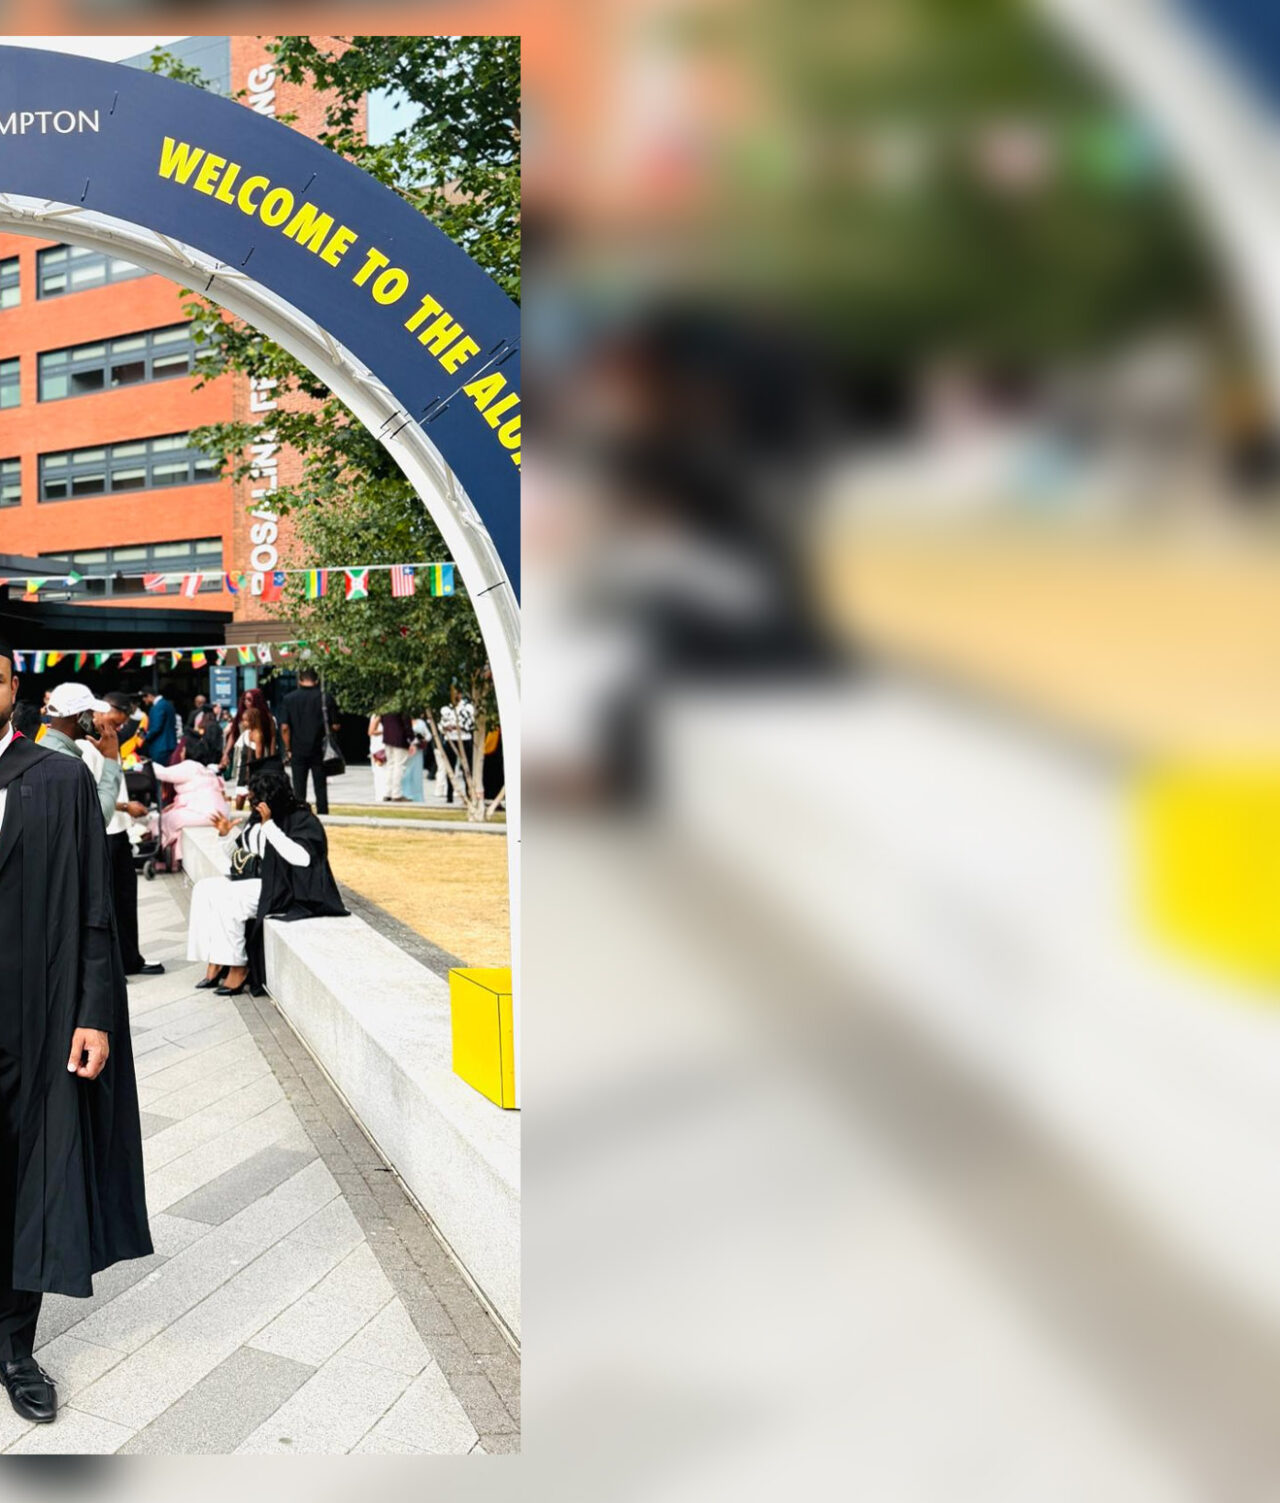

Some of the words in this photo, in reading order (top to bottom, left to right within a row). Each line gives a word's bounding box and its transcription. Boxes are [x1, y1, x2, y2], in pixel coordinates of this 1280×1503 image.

[248, 64, 276, 119] NG
[158, 136, 359, 268] WELCOME
[352, 247, 410, 305] TO
[404, 293, 481, 375] THE
[462, 371, 521, 472] ALU
